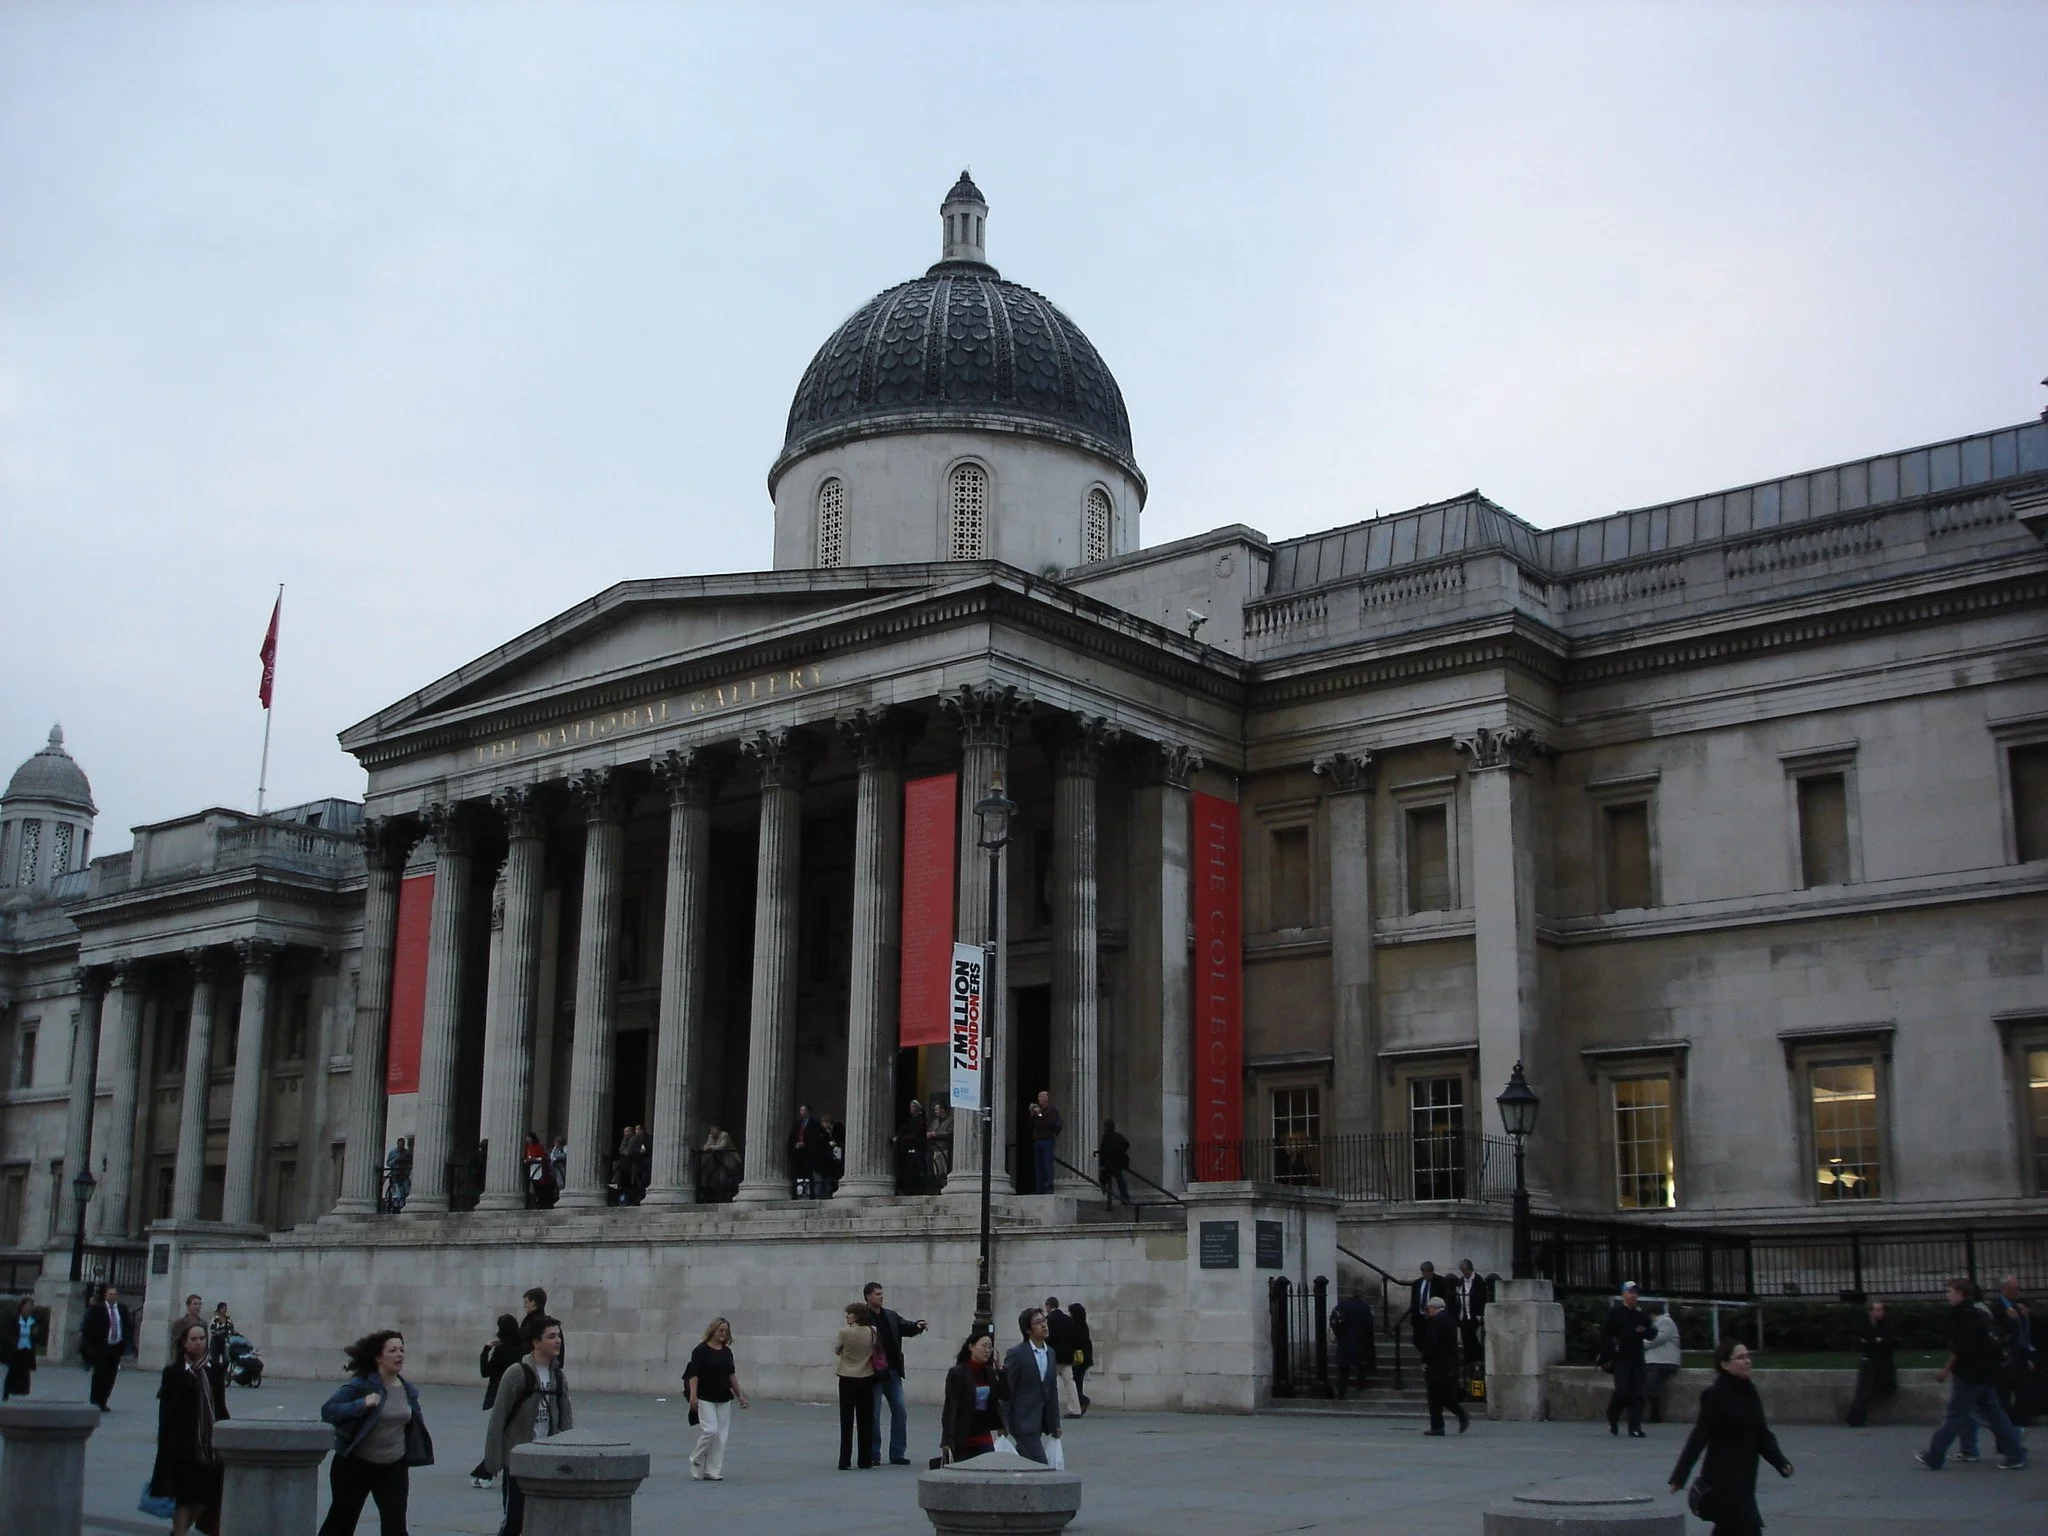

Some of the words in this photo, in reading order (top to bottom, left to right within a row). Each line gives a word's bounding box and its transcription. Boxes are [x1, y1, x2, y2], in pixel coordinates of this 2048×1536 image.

[475, 739, 520, 764] THE
[537, 702, 672, 747] NATIONAL
[690, 664, 824, 712] GALLERY
[1208, 817, 1226, 892] THE
[953, 1056, 968, 1069] 7
[967, 962, 981, 1071] LONDONERS
[1210, 909, 1228, 1172] COLLECTION
